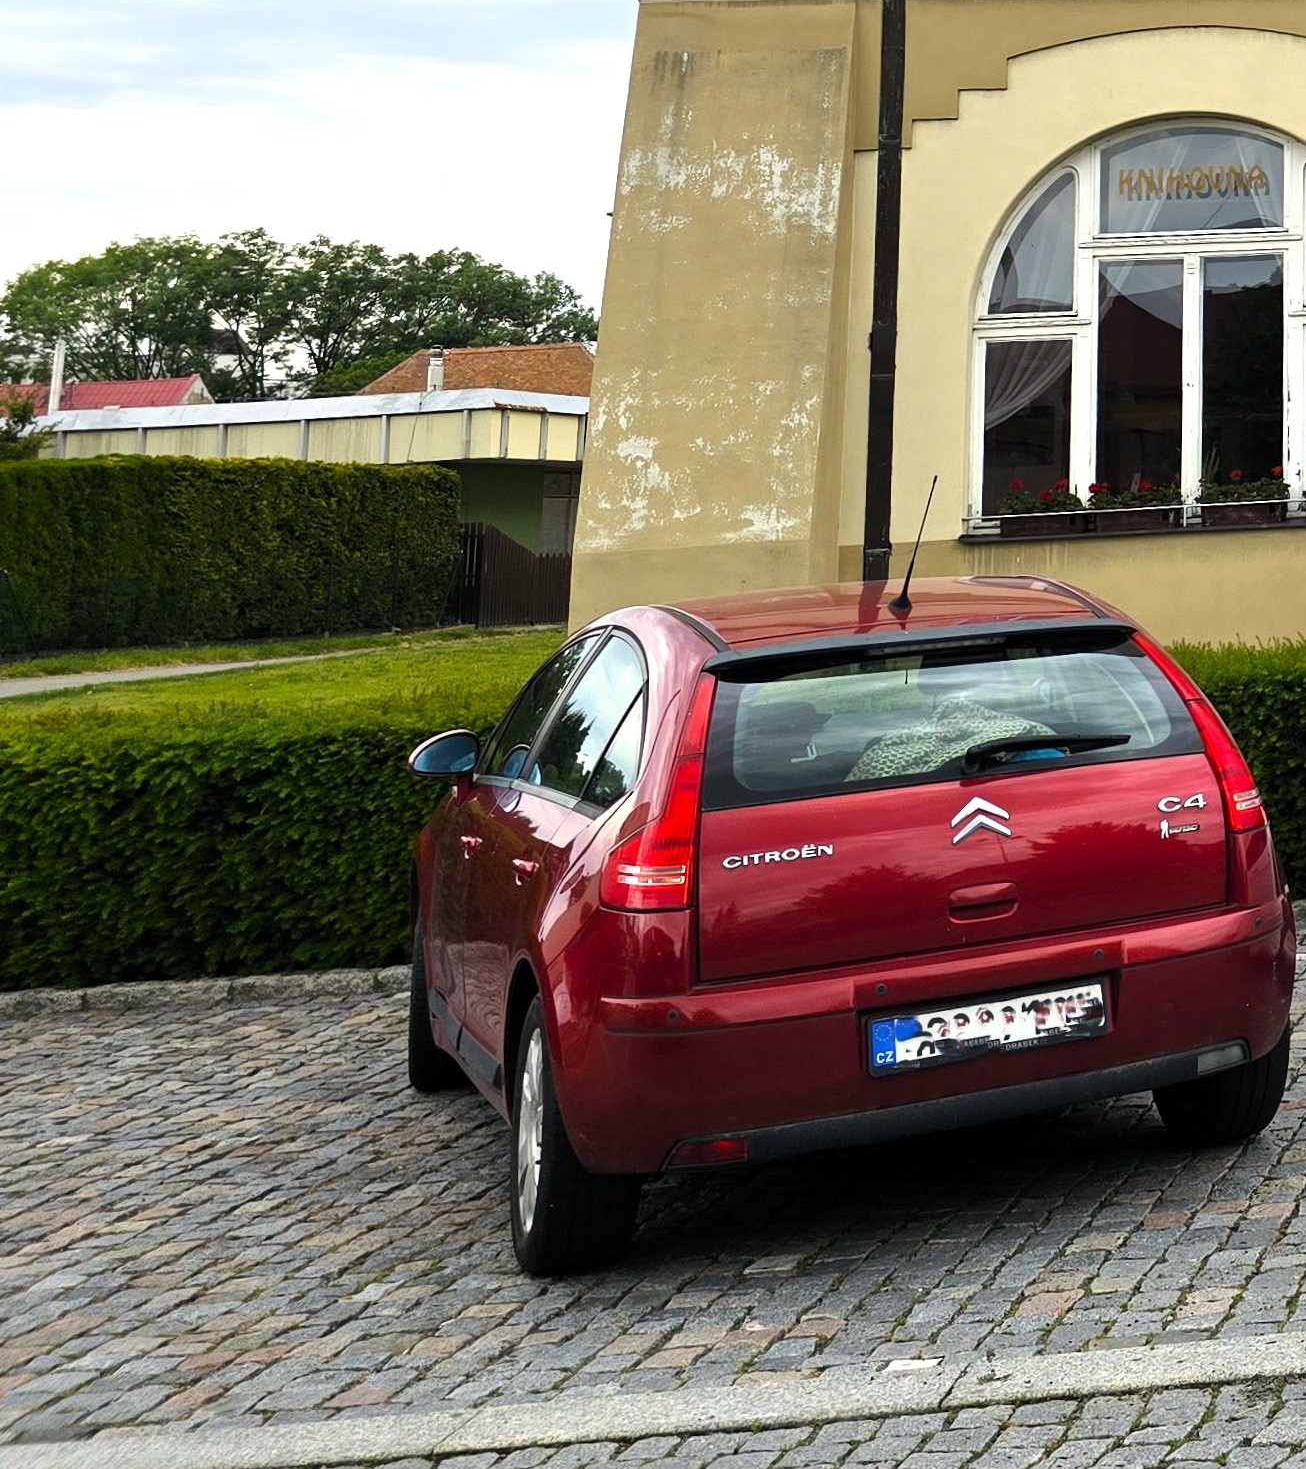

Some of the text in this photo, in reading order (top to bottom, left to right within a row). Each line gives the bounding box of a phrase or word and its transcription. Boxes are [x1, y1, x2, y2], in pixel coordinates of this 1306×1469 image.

[1119, 164, 1266, 197] KNIHOVNA
[1157, 793, 1207, 812] C4
[722, 844, 833, 869] CITROËN
[876, 1049, 894, 1065] CZ
